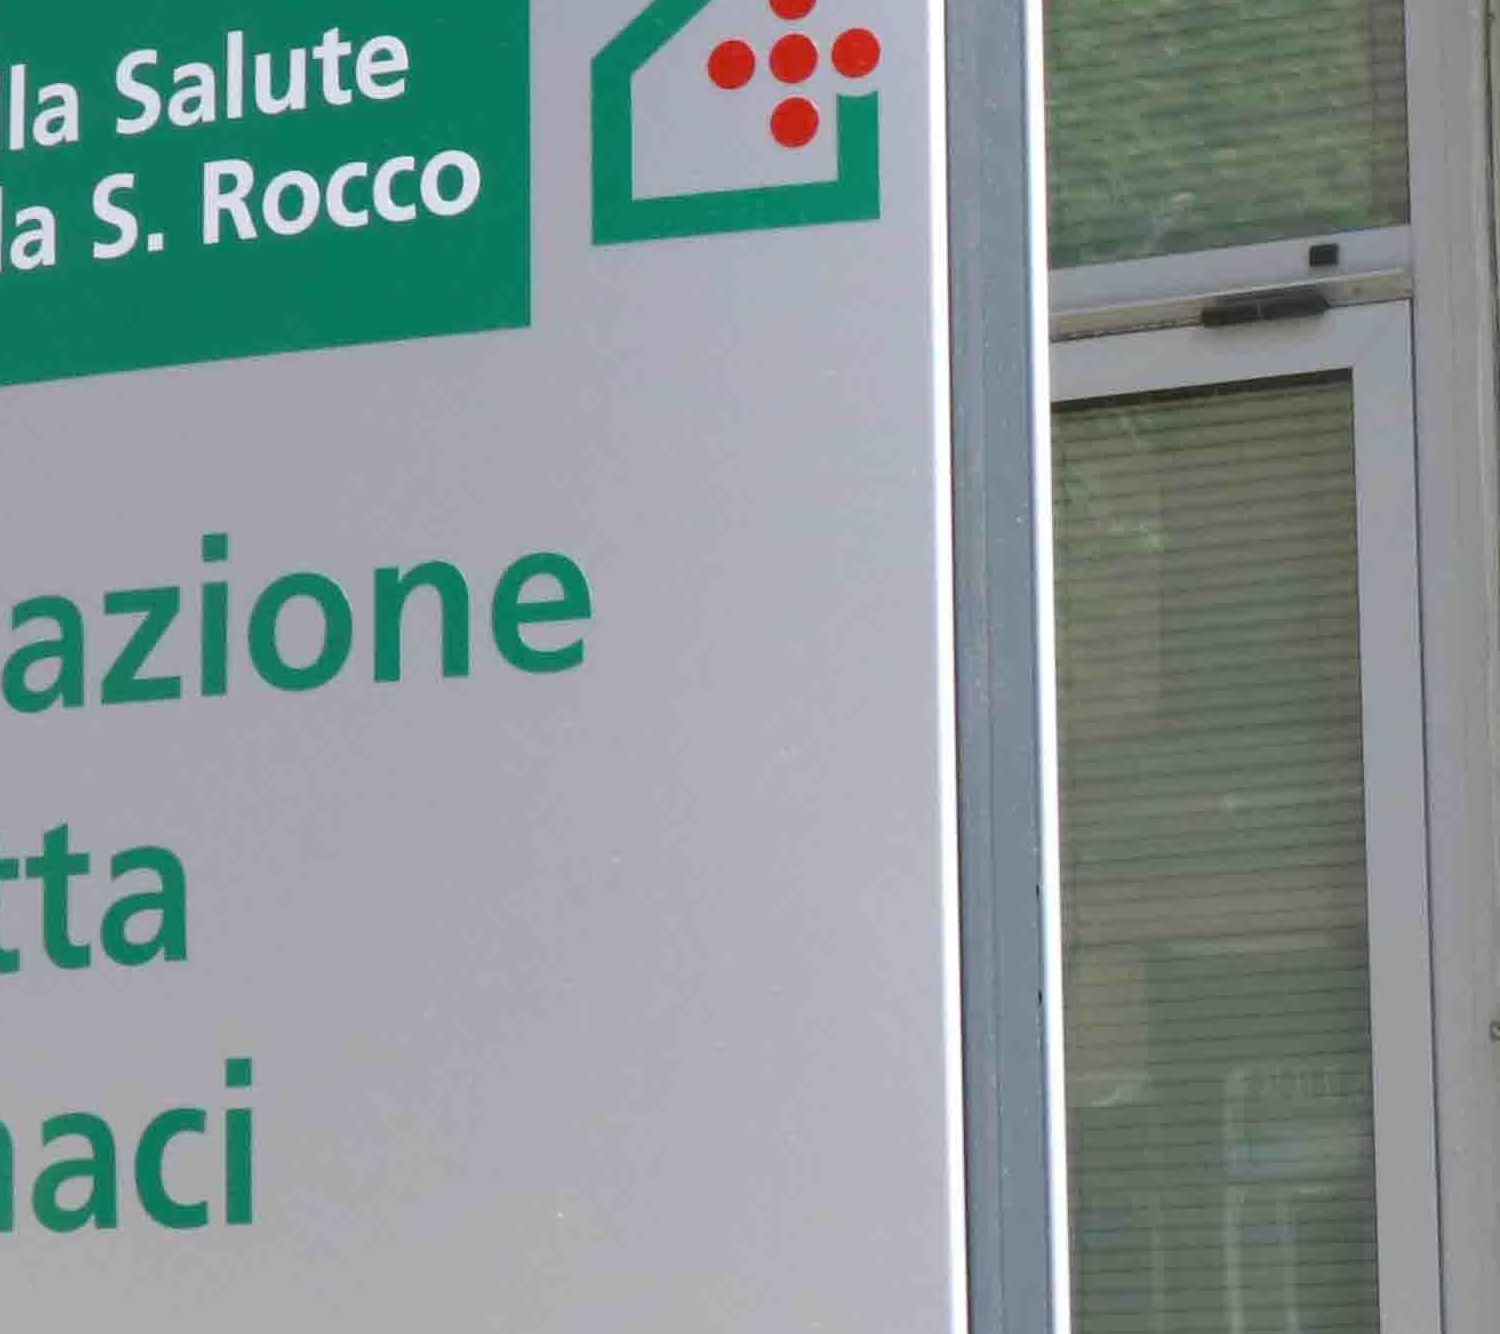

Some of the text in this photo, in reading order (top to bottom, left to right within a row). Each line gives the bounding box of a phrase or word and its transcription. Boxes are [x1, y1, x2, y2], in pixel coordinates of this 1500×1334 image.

[115, 27, 409, 135] Salute
[93, 173, 164, 259] S.
[203, 150, 481, 244] Rocco
